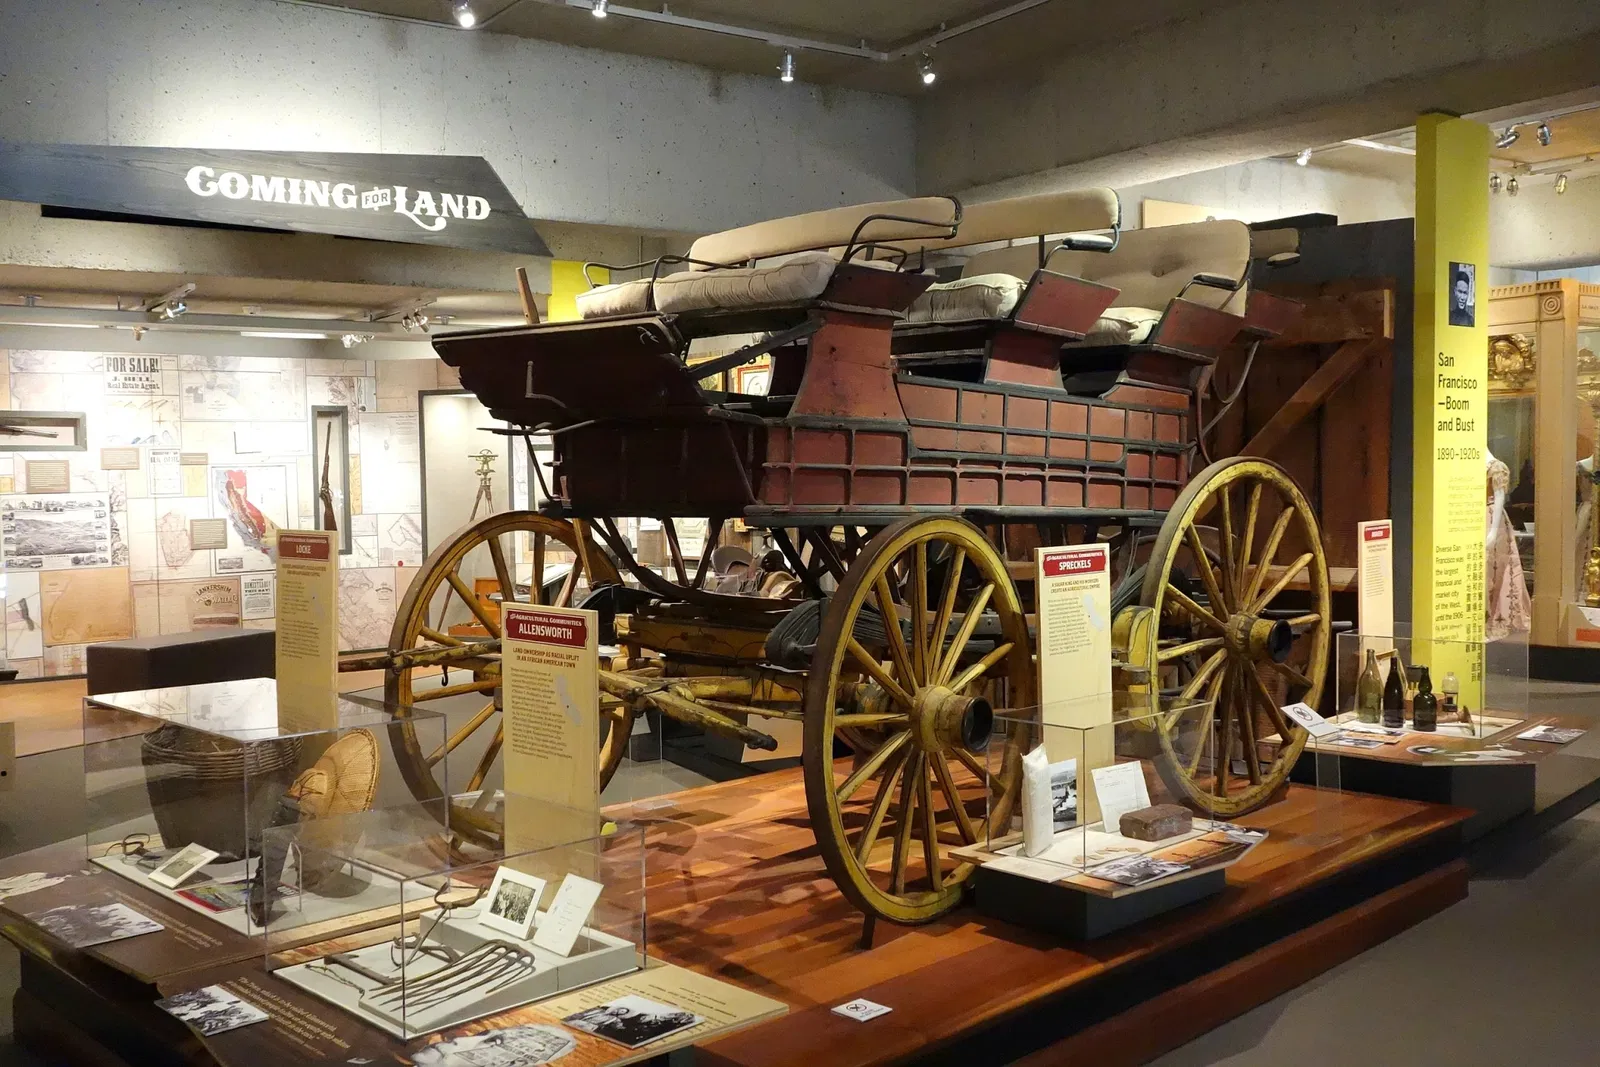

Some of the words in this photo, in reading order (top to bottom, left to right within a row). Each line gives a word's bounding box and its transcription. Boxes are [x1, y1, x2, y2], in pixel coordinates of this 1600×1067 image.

[184, 165, 358, 209] COMING
[364, 191, 389, 206] FOR
[393, 185, 492, 231] LAND
[106, 356, 127, 373] FOR
[129, 357, 159, 373] SALE!
[1438, 352, 1455, 367] San
[1438, 374, 1478, 389] Francisco
[1437, 418, 1453, 432] and
[1456, 417, 1475, 432] Bust
[295, 544, 312, 554] LOCKE
[1059, 559, 1091, 571] SPRECKELS
[196, 584, 232, 596] LANKERSHIM
[516, 614, 549, 623] AGRICULTURAL
[549, 617, 582, 627] COMMUNITIES
[518, 622, 573, 640] ALLENSWORTH
[523, 648, 545, 656] OWNERSHIP
[551, 652, 565, 660] RACIAL
[566, 653, 579, 662] UPLIFT
[527, 656, 543, 664] AFRICAN
[543, 658, 563, 667] AMERICAN
[563, 660, 576, 669] TOWN
